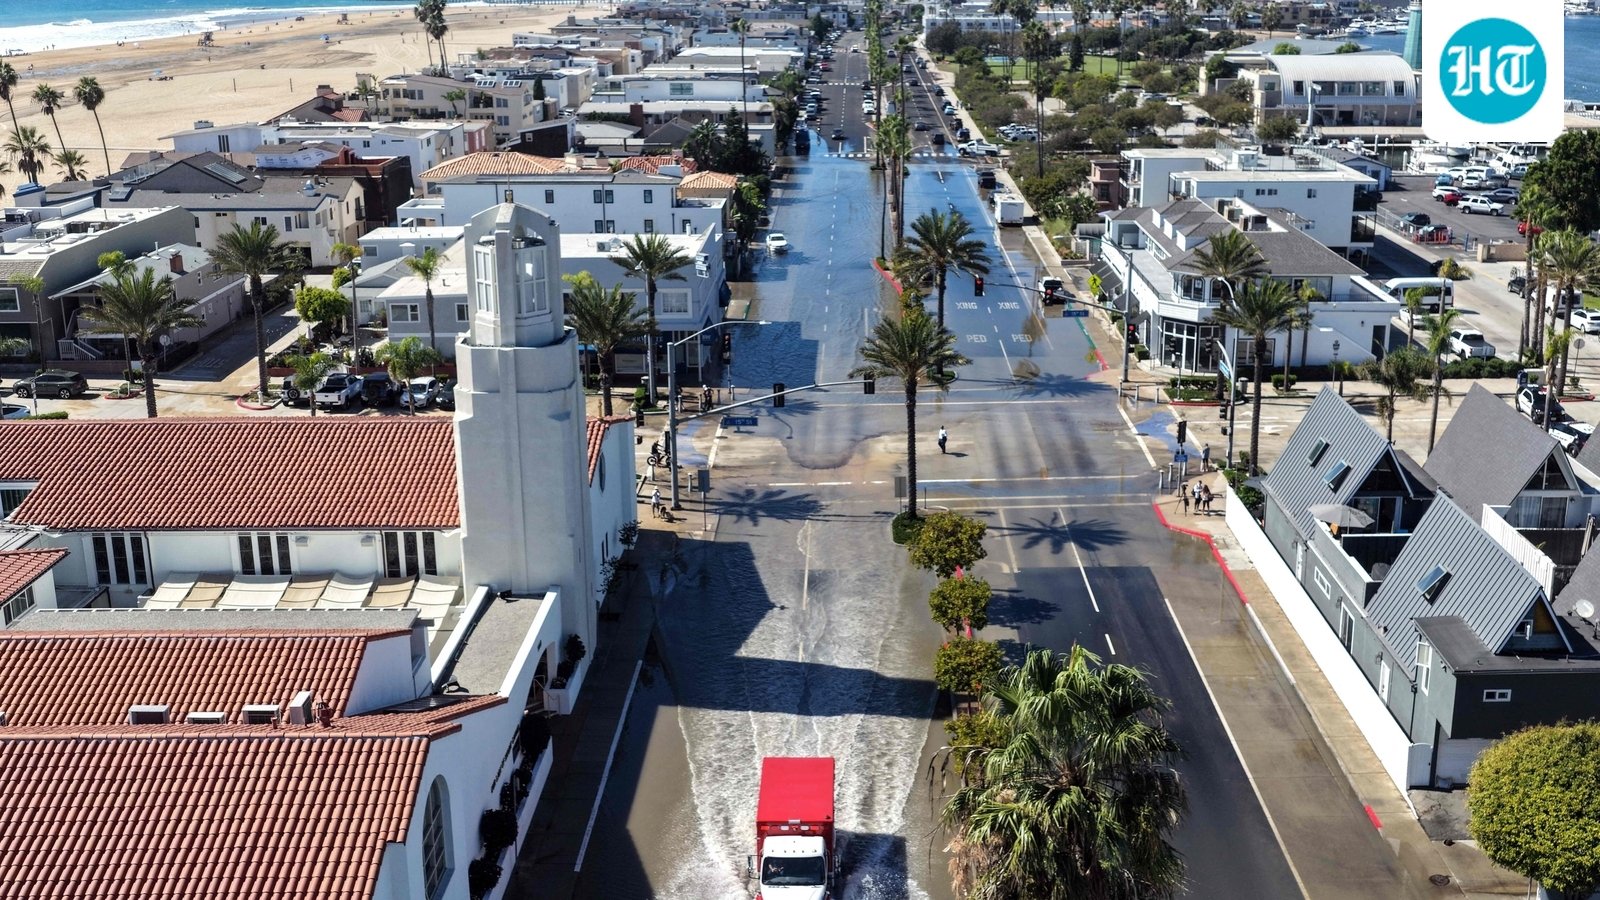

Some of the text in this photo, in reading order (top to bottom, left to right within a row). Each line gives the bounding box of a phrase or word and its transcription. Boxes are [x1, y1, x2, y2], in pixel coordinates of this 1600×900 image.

[955, 302, 978, 310] XING
[997, 302, 1020, 310] XING
[966, 334, 987, 343] PED
[1011, 334, 1033, 343] PED
